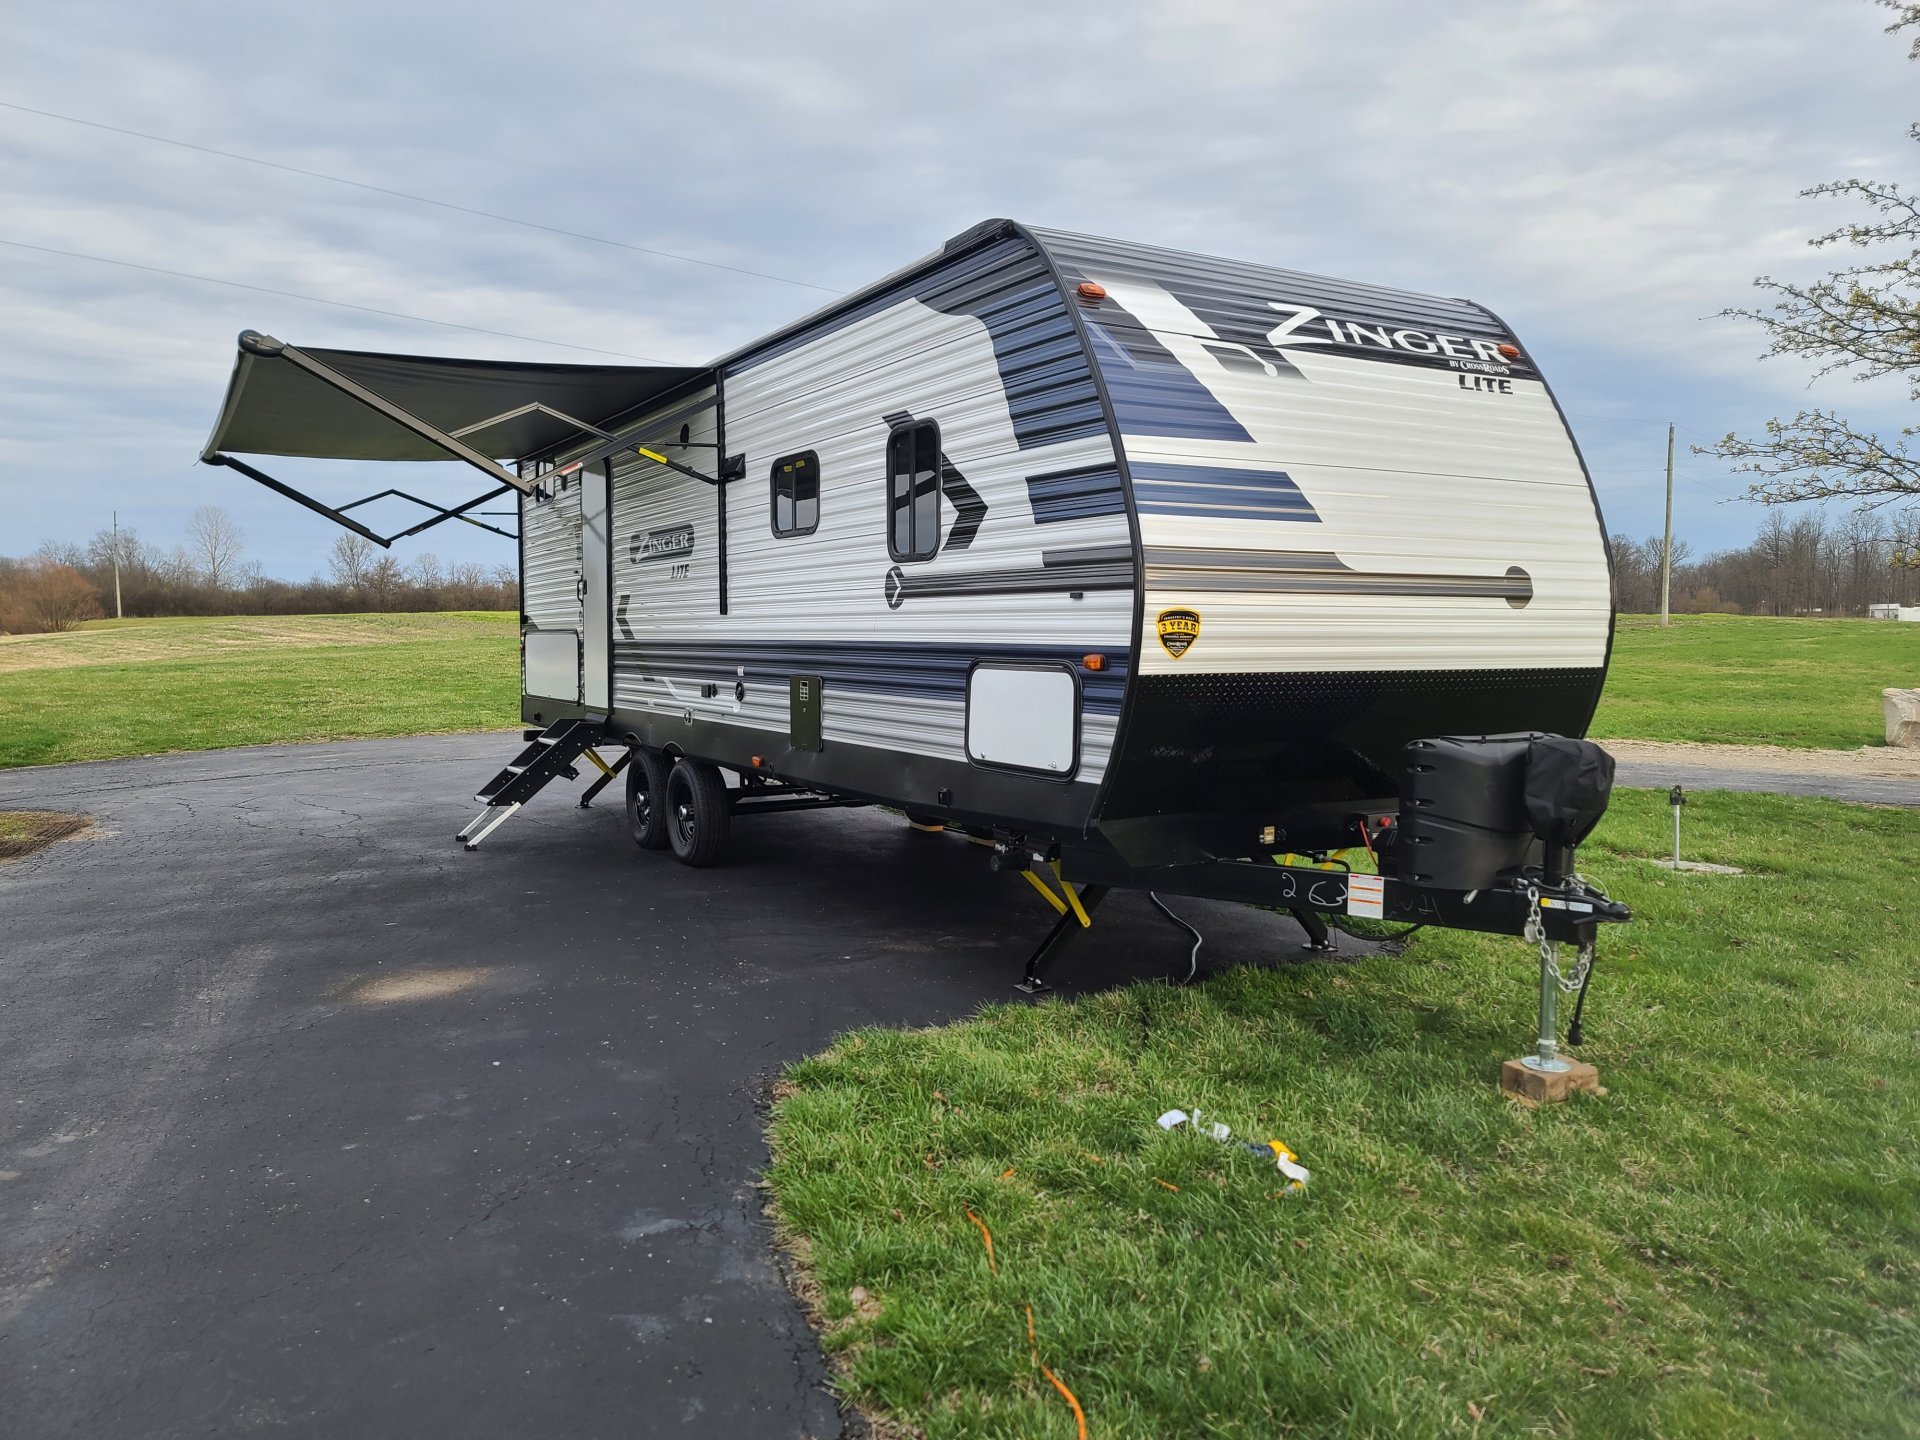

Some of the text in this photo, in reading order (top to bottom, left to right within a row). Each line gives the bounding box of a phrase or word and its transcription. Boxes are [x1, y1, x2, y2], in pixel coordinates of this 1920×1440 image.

[1266, 302, 1511, 363] ZINGER
[1449, 360, 1459, 368] BY
[1458, 374, 1513, 395] LITE
[635, 532, 689, 563] ZINGER
[671, 564, 689, 579] LITE
[1161, 620, 1197, 632] 3 YEAR
